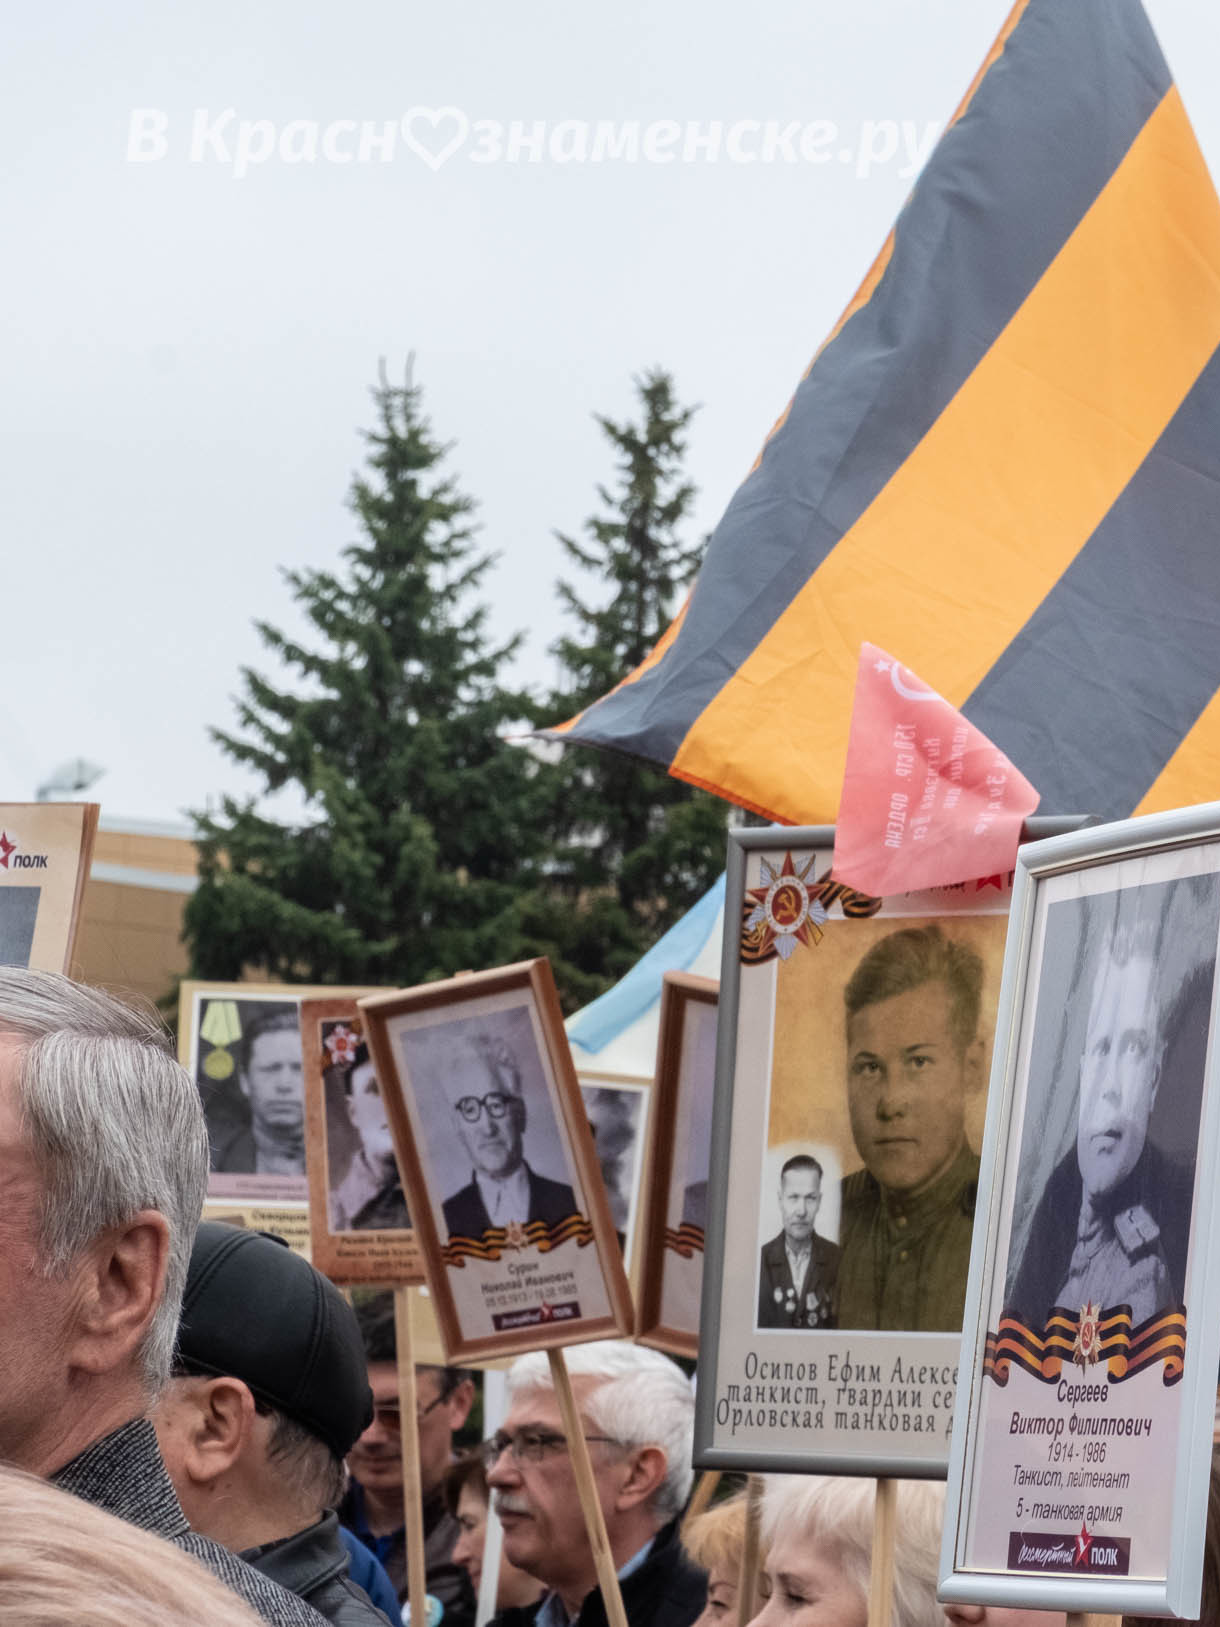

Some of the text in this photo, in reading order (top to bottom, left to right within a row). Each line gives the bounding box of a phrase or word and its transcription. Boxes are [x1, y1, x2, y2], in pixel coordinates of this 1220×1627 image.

[745, 1352, 818, 1381] Осипов
[828, 1350, 881, 1391] Ефим
[727, 1384, 826, 1408] танкист,
[836, 1388, 921, 1414] гвардии
[1057, 1379, 1109, 1408] Сергеев
[716, 1398, 824, 1436] Орловская
[834, 1412, 937, 1433] танковая
[1009, 1411, 1153, 1441] Виктор Филиппович
[1012, 1464, 1130, 1490] Танкист, лейтенант
[1031, 1502, 1085, 1521] танковая
[1086, 1505, 1123, 1526] армия
